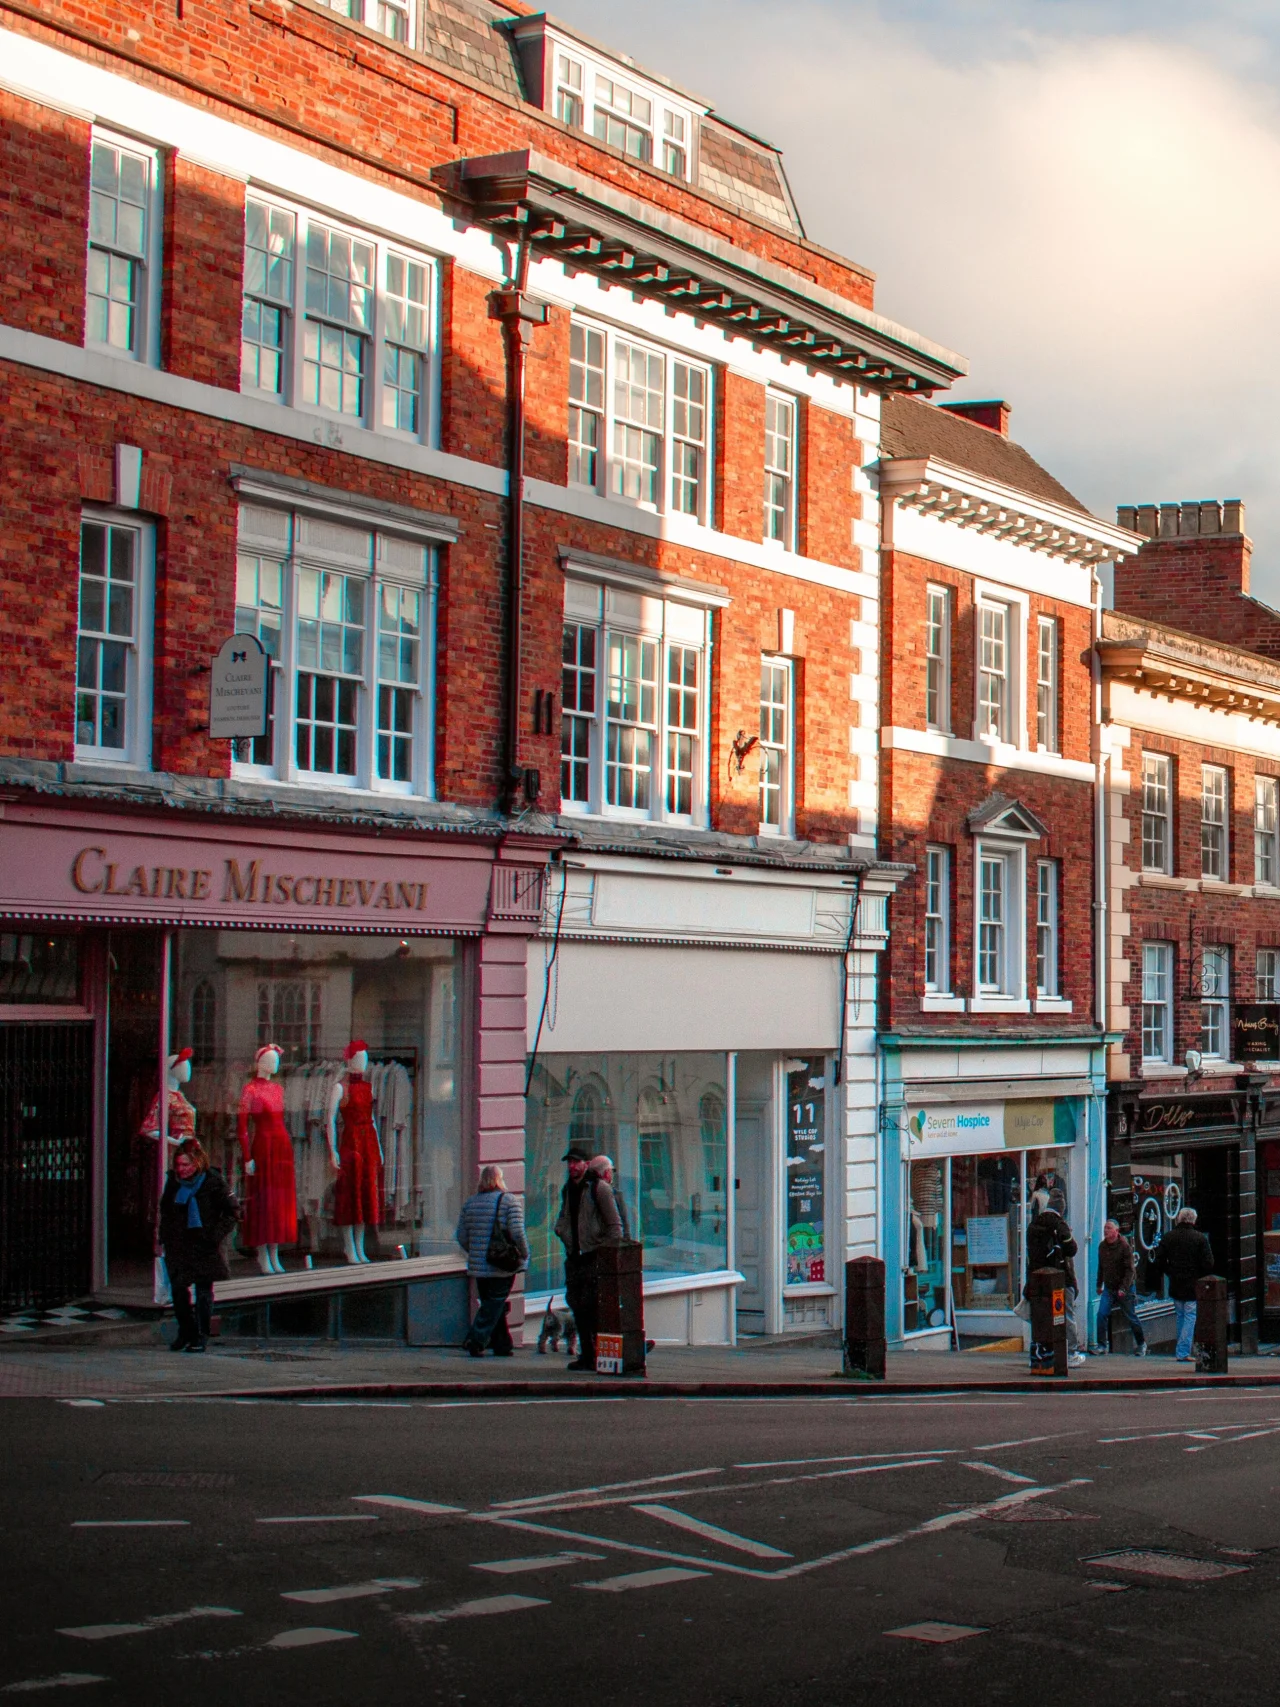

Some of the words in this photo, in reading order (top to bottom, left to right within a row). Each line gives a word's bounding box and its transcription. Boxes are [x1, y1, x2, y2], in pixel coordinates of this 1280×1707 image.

[72, 846, 212, 901] CLAIRE
[222, 858, 430, 911] MISCHEVANI
[793, 1103, 815, 1124] 11
[927, 1116, 955, 1130] Severn
[957, 1113, 990, 1129] Hospice
[1014, 1116, 1030, 1130] Wyle
[1031, 1115, 1044, 1128] Cop
